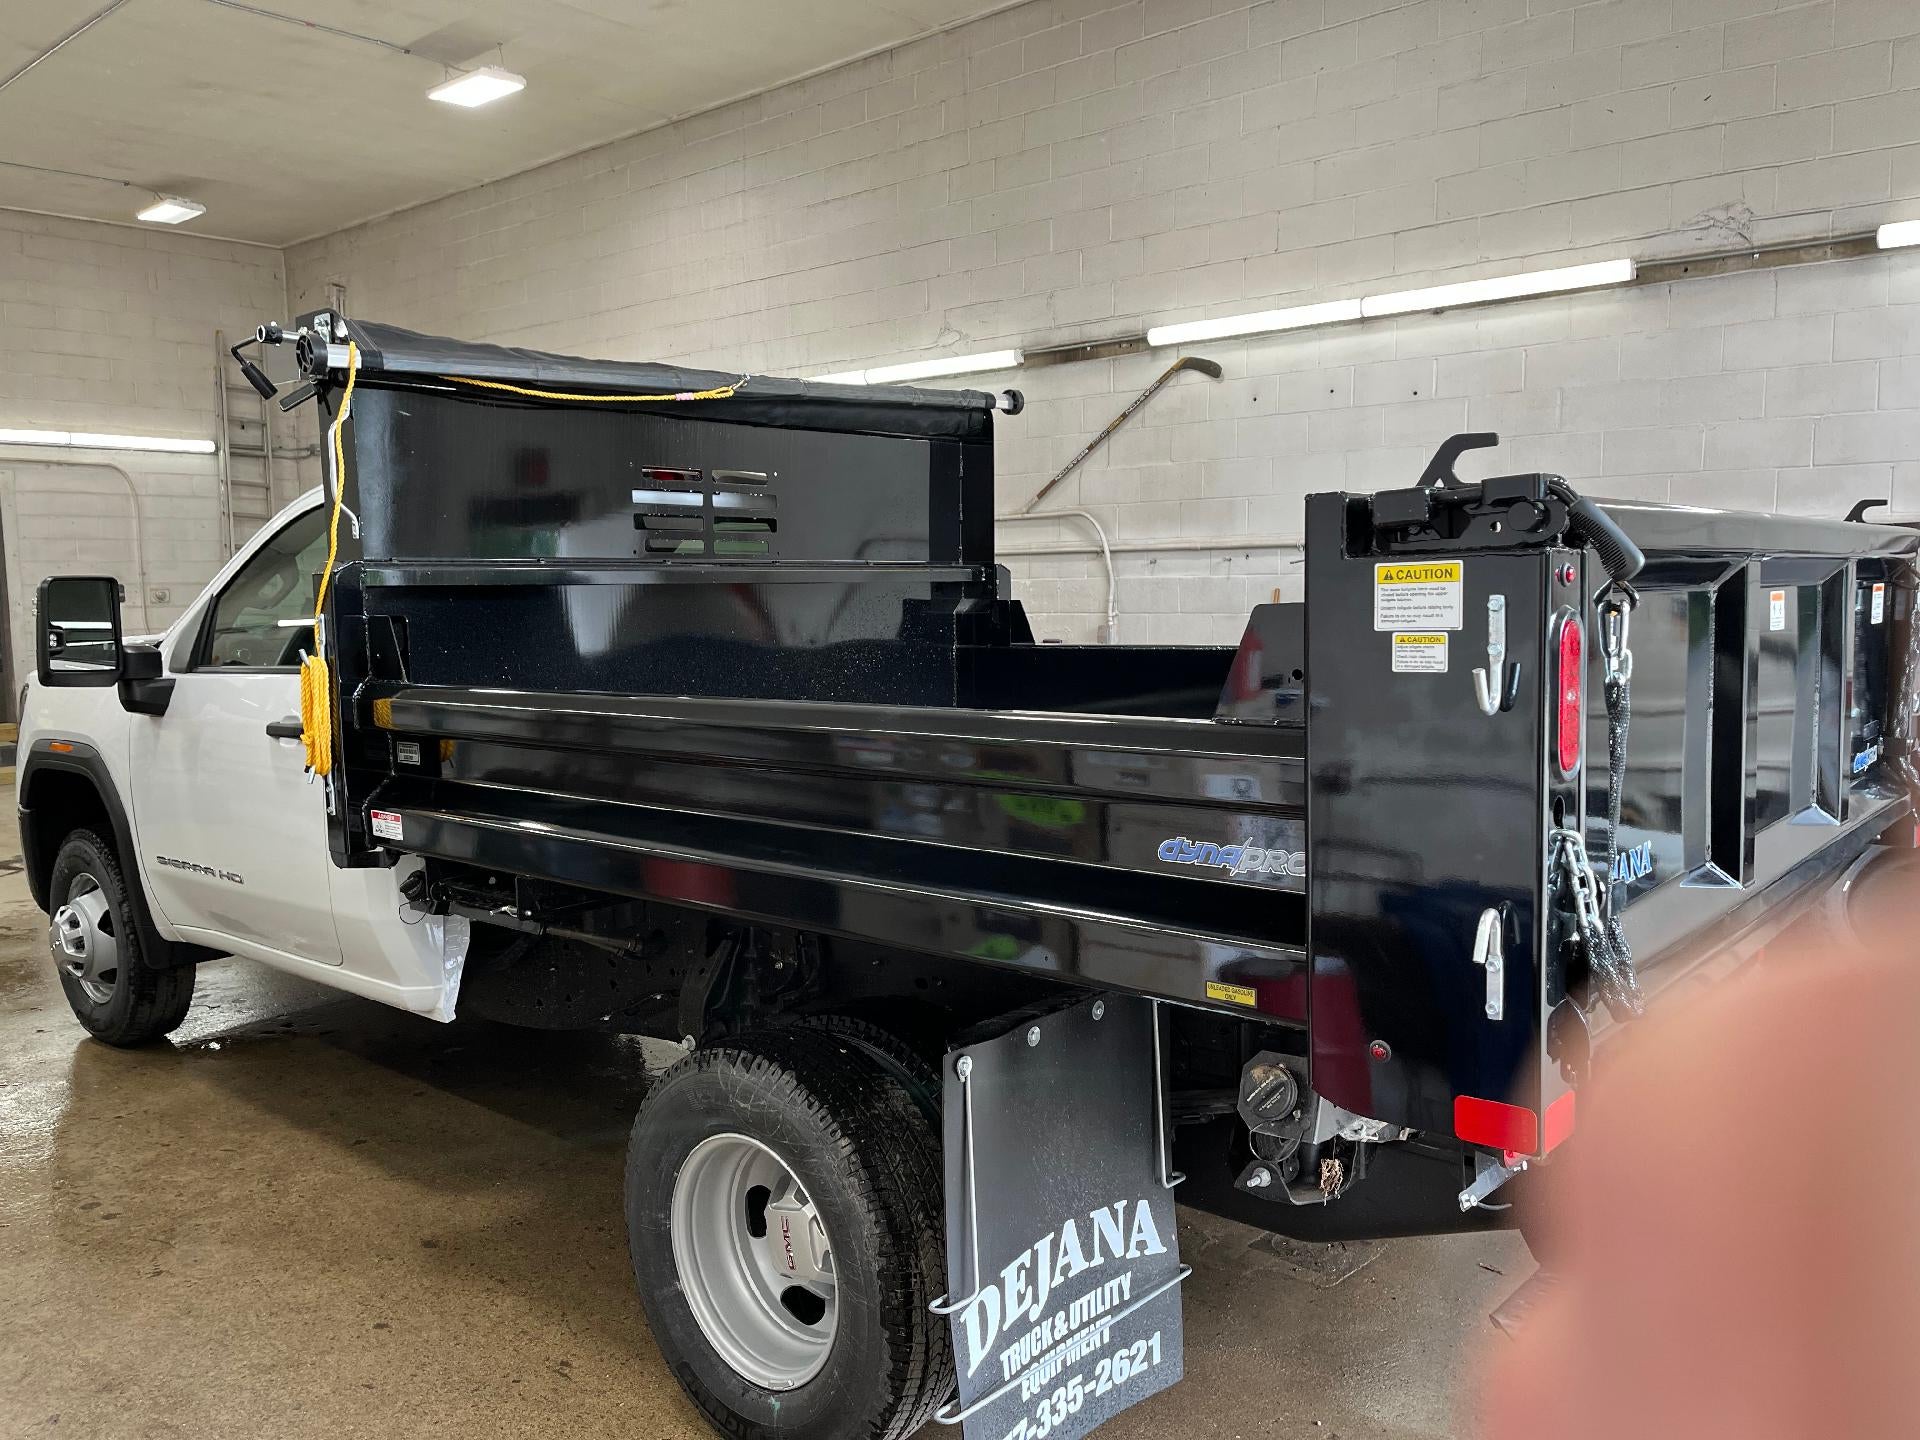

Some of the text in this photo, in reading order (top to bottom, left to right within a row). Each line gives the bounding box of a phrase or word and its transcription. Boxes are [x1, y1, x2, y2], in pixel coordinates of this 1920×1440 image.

[1395, 568, 1453, 580] CAUTION
[156, 856, 244, 885] SIERRA HD
[1208, 983, 1254, 998] UNLEADED GASOLINE
[780, 1215, 796, 1271] GMC
[960, 1199, 1168, 1379] DEJANA
[1000, 1271, 1132, 1382] TRUCK & UTILITY
[1020, 1315, 1112, 1402] EQUIPMENT
